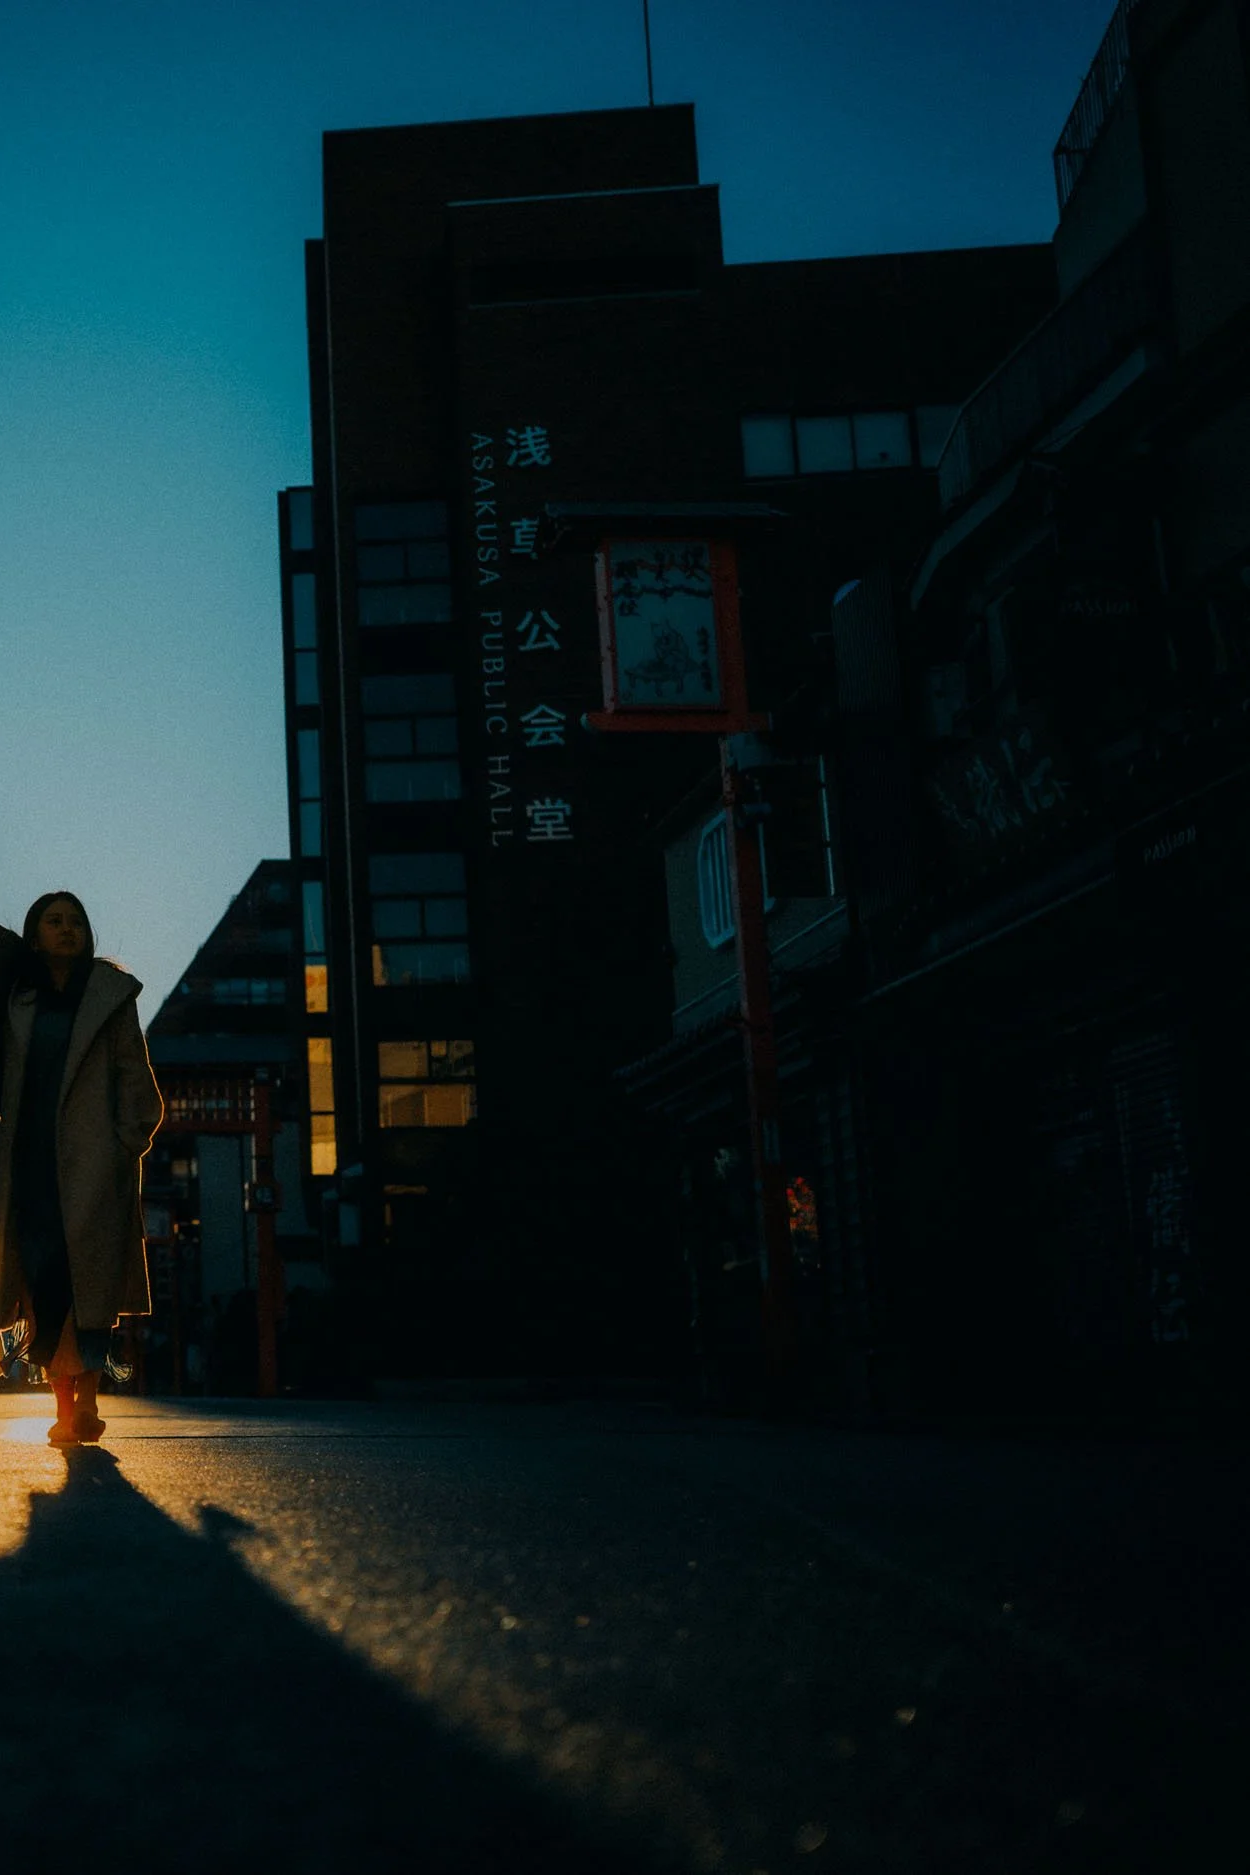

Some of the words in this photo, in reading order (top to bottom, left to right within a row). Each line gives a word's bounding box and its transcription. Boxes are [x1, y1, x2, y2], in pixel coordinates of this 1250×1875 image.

[469, 431, 502, 588] ASAKUSA
[479, 607, 509, 736] PUBLIC
[504, 423, 576, 843] 浅草公会堂
[487, 754, 514, 847] HALL
